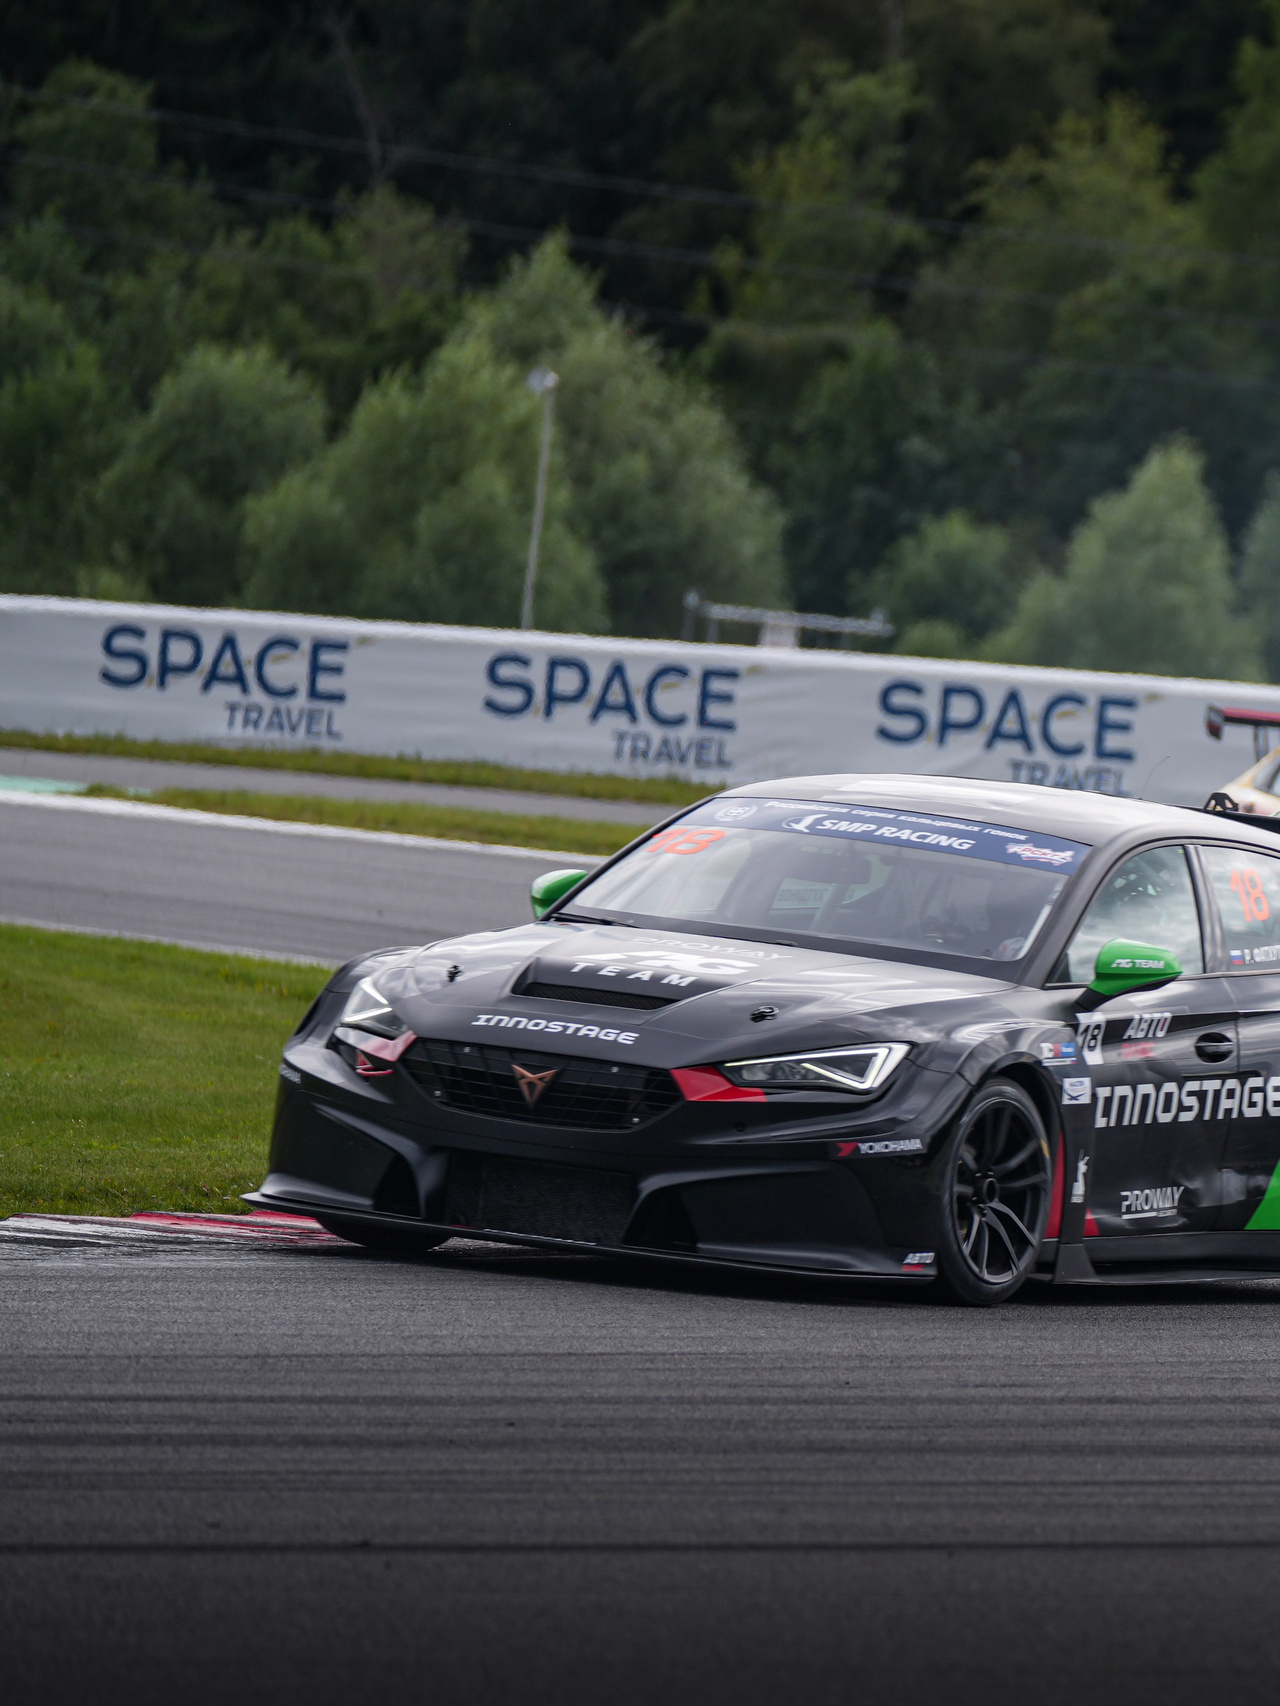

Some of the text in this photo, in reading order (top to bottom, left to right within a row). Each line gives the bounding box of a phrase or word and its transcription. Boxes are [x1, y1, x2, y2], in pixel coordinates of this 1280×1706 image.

[100, 622, 350, 703] SPACE
[484, 652, 742, 732] SPACE
[224, 701, 344, 741] TRAVEL
[875, 679, 1138, 763] SPACE
[613, 730, 733, 770] TRAVEL
[1007, 758, 1132, 797] TRAVEL
[646, 827, 726, 855] 18
[816, 820, 976, 850] SMP RACING
[1230, 868, 1270, 922] 18
[630, 937, 795, 960] PROWAY
[570, 962, 699, 987] TEAM
[1133, 959, 1165, 969] TEAM
[471, 1014, 640, 1045] INNOSTAGE
[1080, 1024, 1102, 1052] 18
[858, 1138, 923, 1154] YOKOHAMA
[1120, 1186, 1185, 1213] PROWAY
